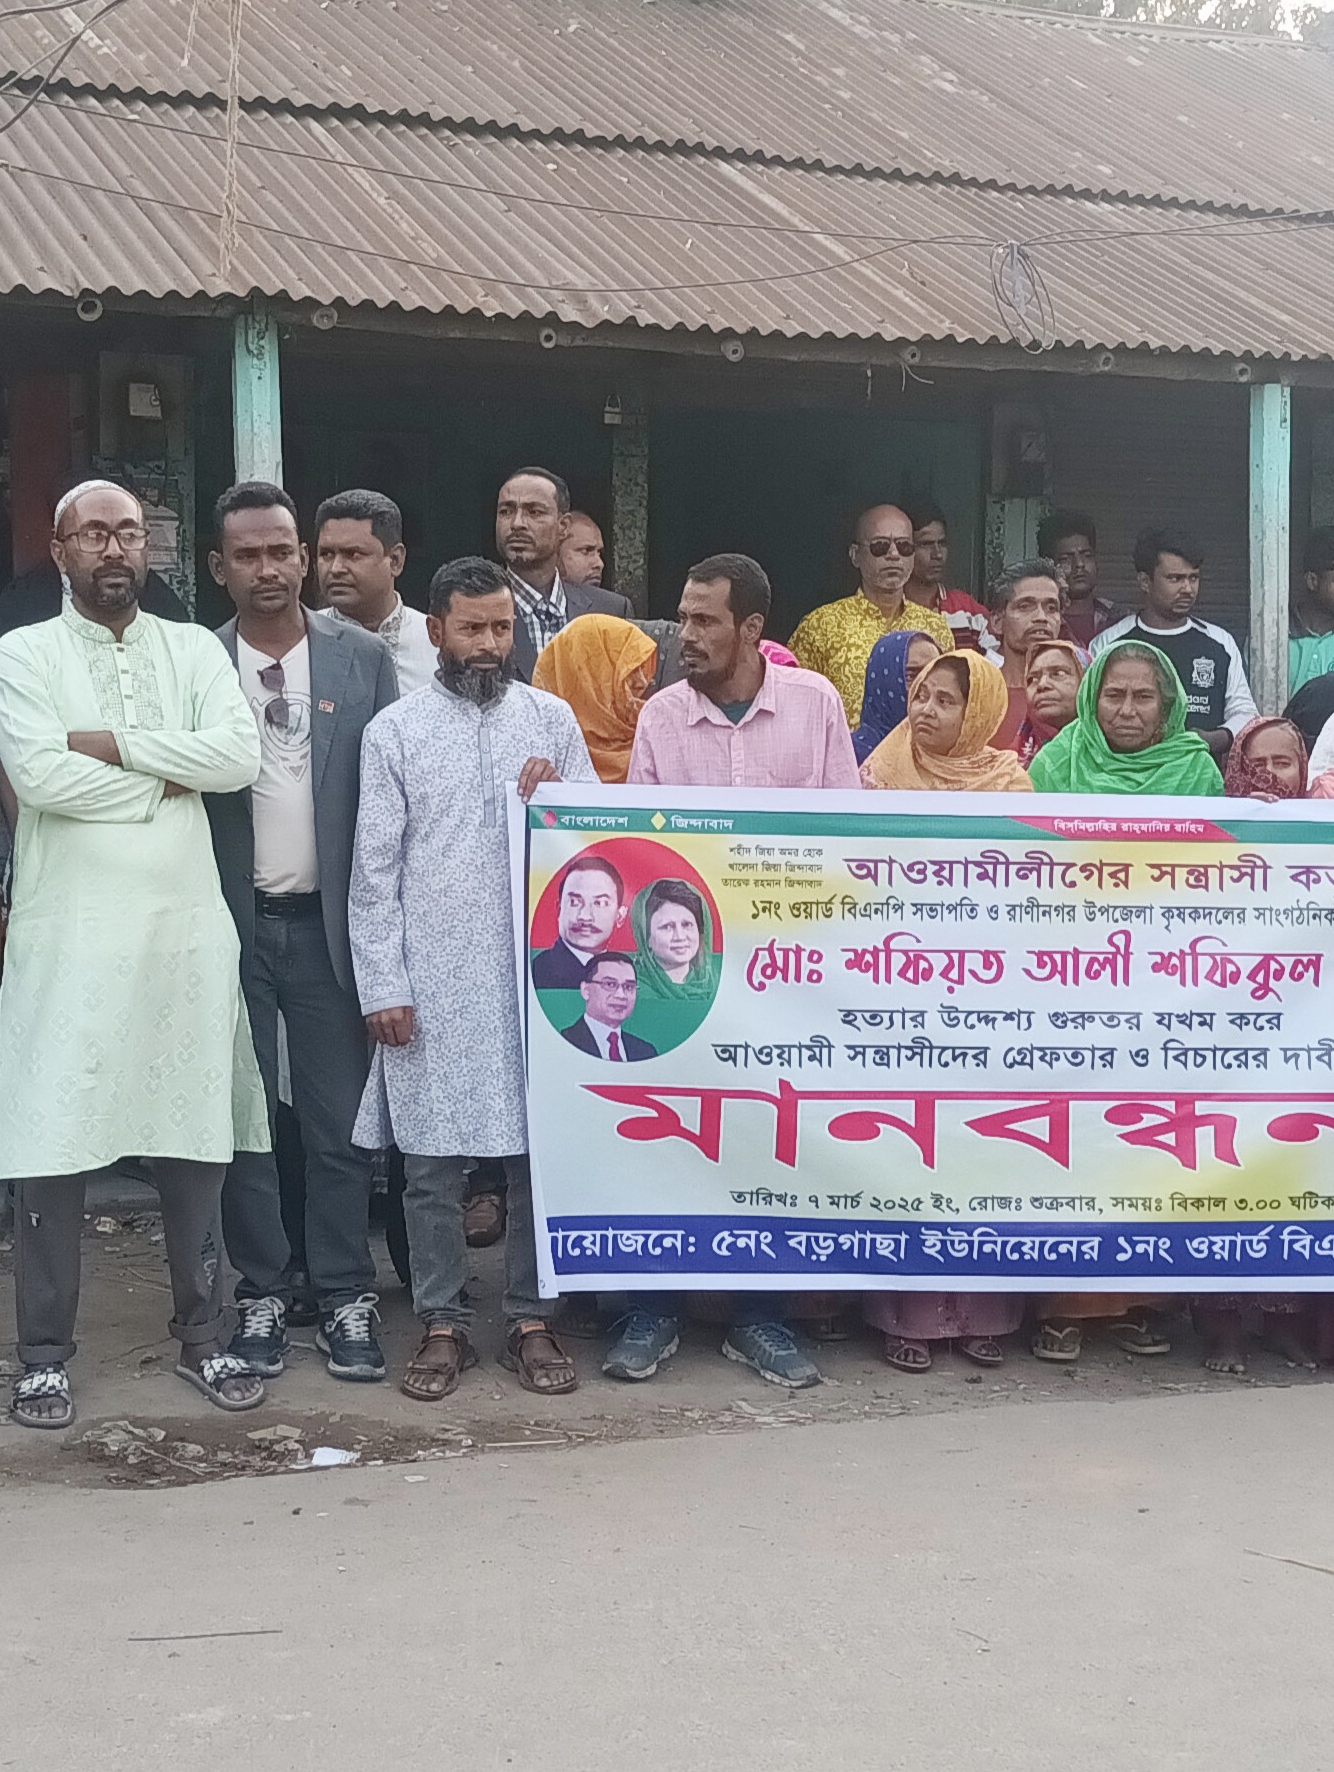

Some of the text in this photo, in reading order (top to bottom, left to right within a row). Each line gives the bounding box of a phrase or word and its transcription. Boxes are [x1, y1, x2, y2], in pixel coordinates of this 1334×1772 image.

[559, 813, 734, 831] বাংলাদেশ জিন্দাবাদ
[844, 849, 1134, 891] আওয়ামীলীগের
[1146, 852, 1272, 893] সন্ত্রাসী
[751, 899, 782, 922] ১নং
[788, 894, 837, 921] ওয়ার্ড
[841, 895, 905, 922] বিএনপি
[912, 896, 979, 923] সভাপতি
[987, 905, 999, 922] ও
[1007, 898, 1076, 924] রাণীনগর
[1083, 899, 1154, 924] উপজেলা
[1160, 906, 1245, 932] কৃষকদলের
[746, 936, 824, 992] মোঃ
[842, 932, 1006, 994] শফিয়ত
[1022, 929, 1134, 987] আলী
[1149, 936, 1325, 1003] শফিকুল
[838, 1003, 1283, 1033] হত্যার উদ্দেশ্য গুরুতর যখম করে
[712, 1036, 834, 1069] আওয়ামী
[847, 1036, 989, 1070] সন্ত্রাসীদের
[1003, 1045, 1116, 1070] গ্রেফতার
[1129, 1047, 1149, 1070] ও
[1161, 1038, 1269, 1072] বিচারের
[730, 1188, 797, 1208] তারিখঃ
[809, 1195, 820, 1209] ৭
[827, 1188, 863, 1210] মার্চ
[870, 1196, 924, 1213] ২০২৫
[930, 1189, 960, 1215] ইং,
[969, 1196, 1022, 1213] রোজঃ
[1030, 1194, 1103, 1215] শুক্রবার,
[1109, 1195, 1163, 1213] সময়ঃ
[1169, 1190, 1226, 1212] বিকাল
[1234, 1196, 1281, 1213] ৩.০০
[712, 1230, 775, 1259] ৫নং
[786, 1228, 908, 1262] বড়গাছা
[919, 1226, 1102, 1263] ইউনিয়েনের
[1115, 1237, 1172, 1263] ১নং
[1184, 1224, 1274, 1261] ওয়ার্ড
